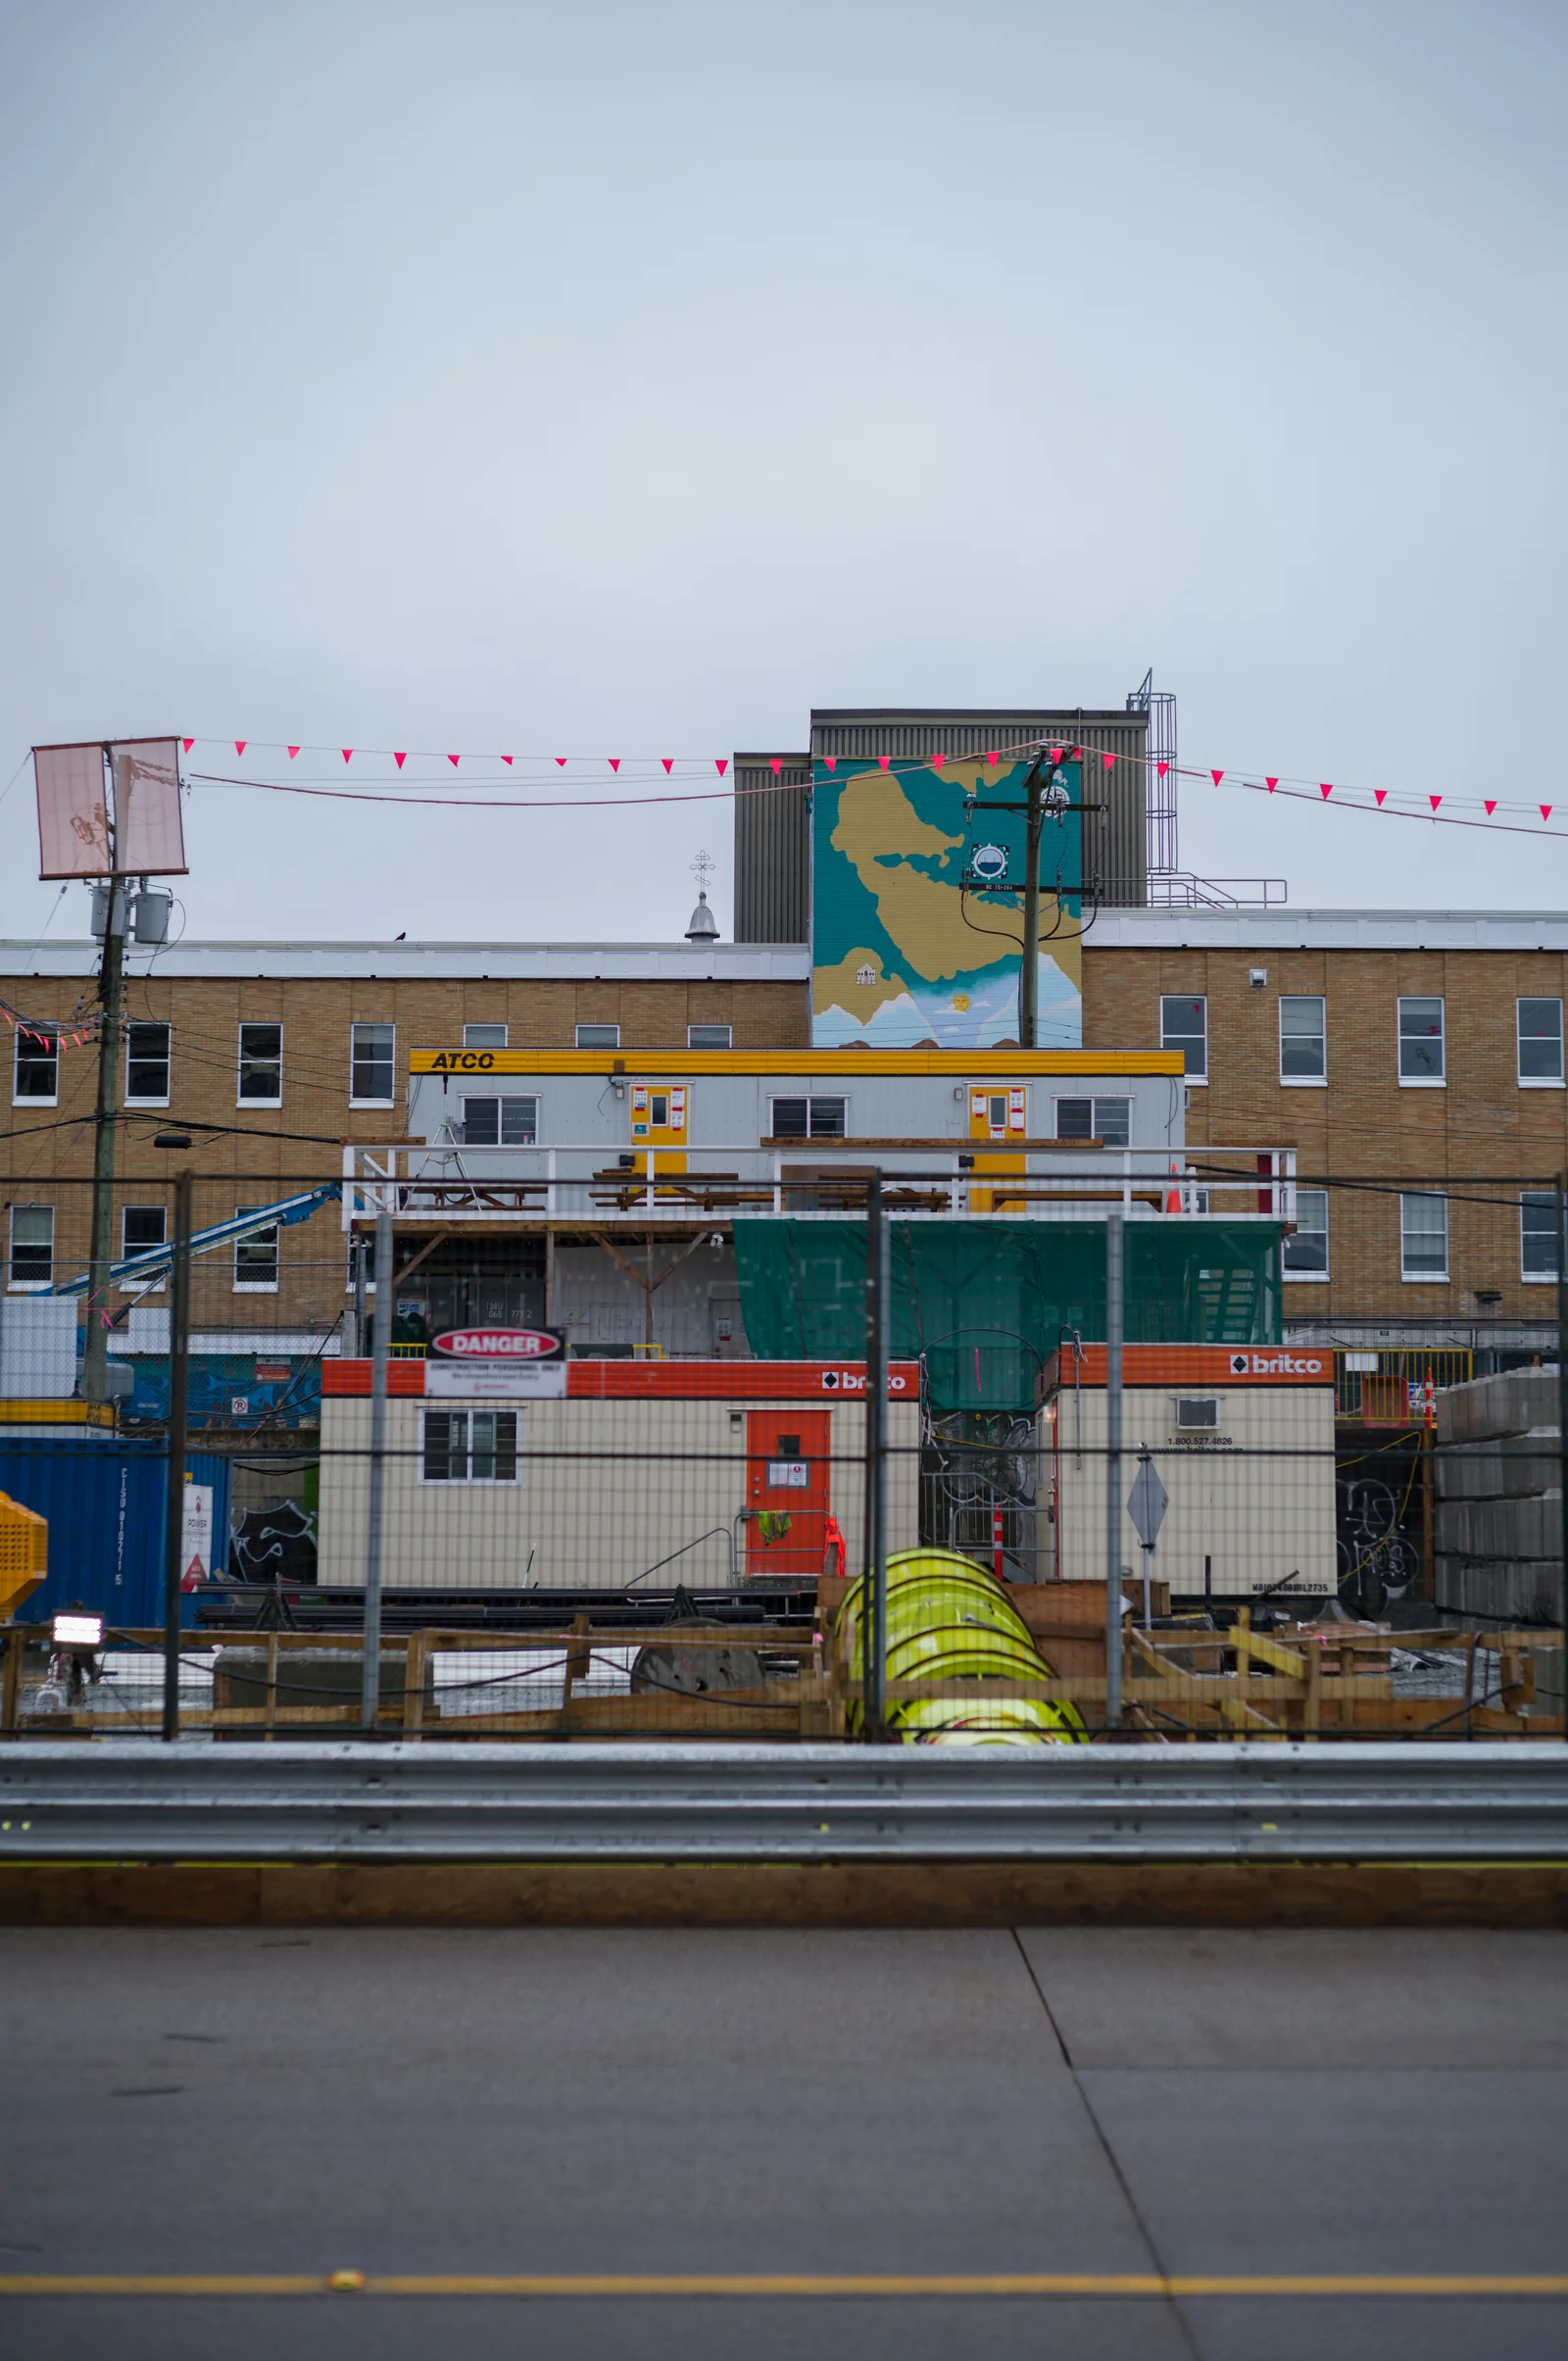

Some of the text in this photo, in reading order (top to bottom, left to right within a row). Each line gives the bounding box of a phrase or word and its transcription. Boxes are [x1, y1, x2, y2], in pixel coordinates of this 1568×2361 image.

[431, 1053, 495, 1069] ATCO
[452, 1335, 541, 1353] DANGER
[1252, 1354, 1322, 1373] britco
[842, 1371, 906, 1390] bro
[1167, 1437, 1233, 1446] 1.800.527.4826
